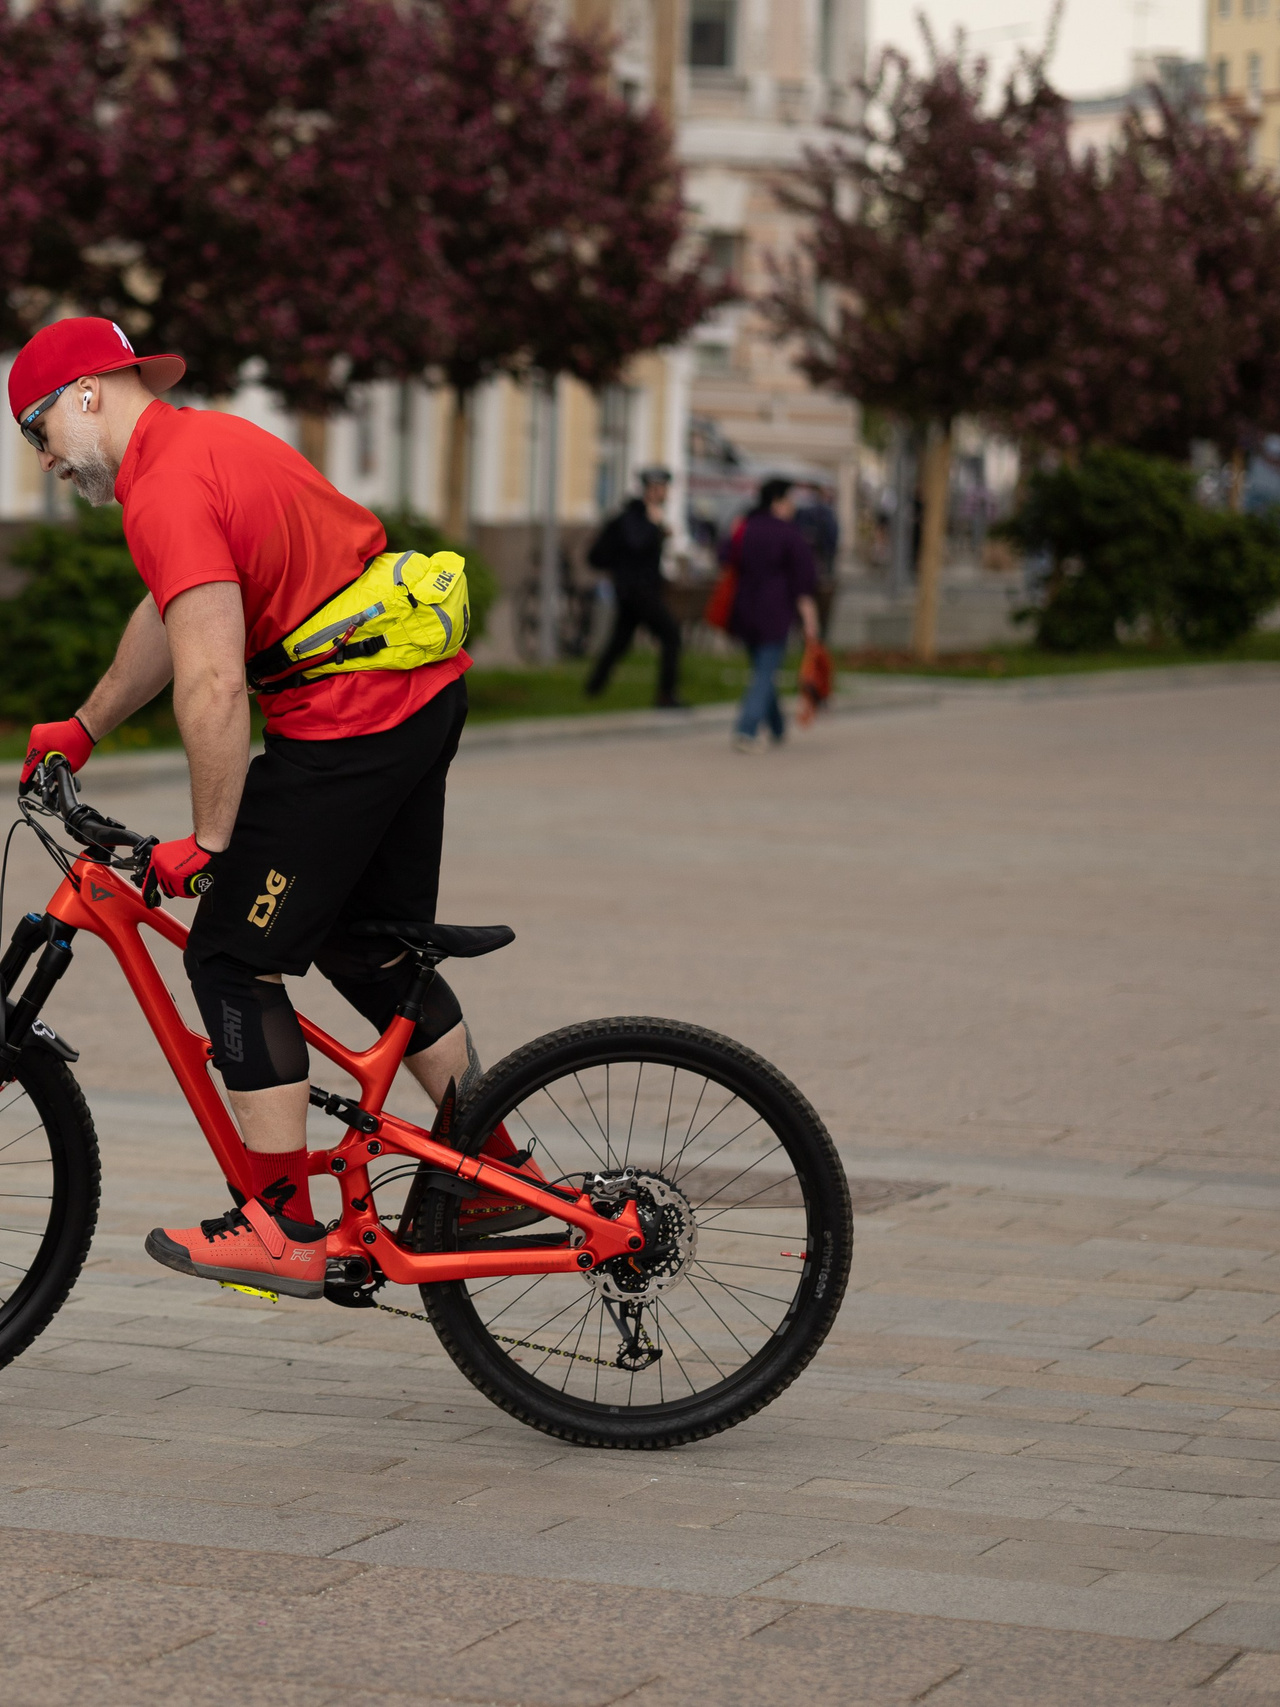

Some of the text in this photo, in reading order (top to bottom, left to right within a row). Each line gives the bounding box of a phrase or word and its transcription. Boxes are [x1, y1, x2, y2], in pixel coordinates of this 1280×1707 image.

[247, 868, 287, 928] TSG
[221, 999, 244, 1062] LEATT
[439, 1097, 454, 1135] Gorilla
[290, 1248, 316, 1262] RC
